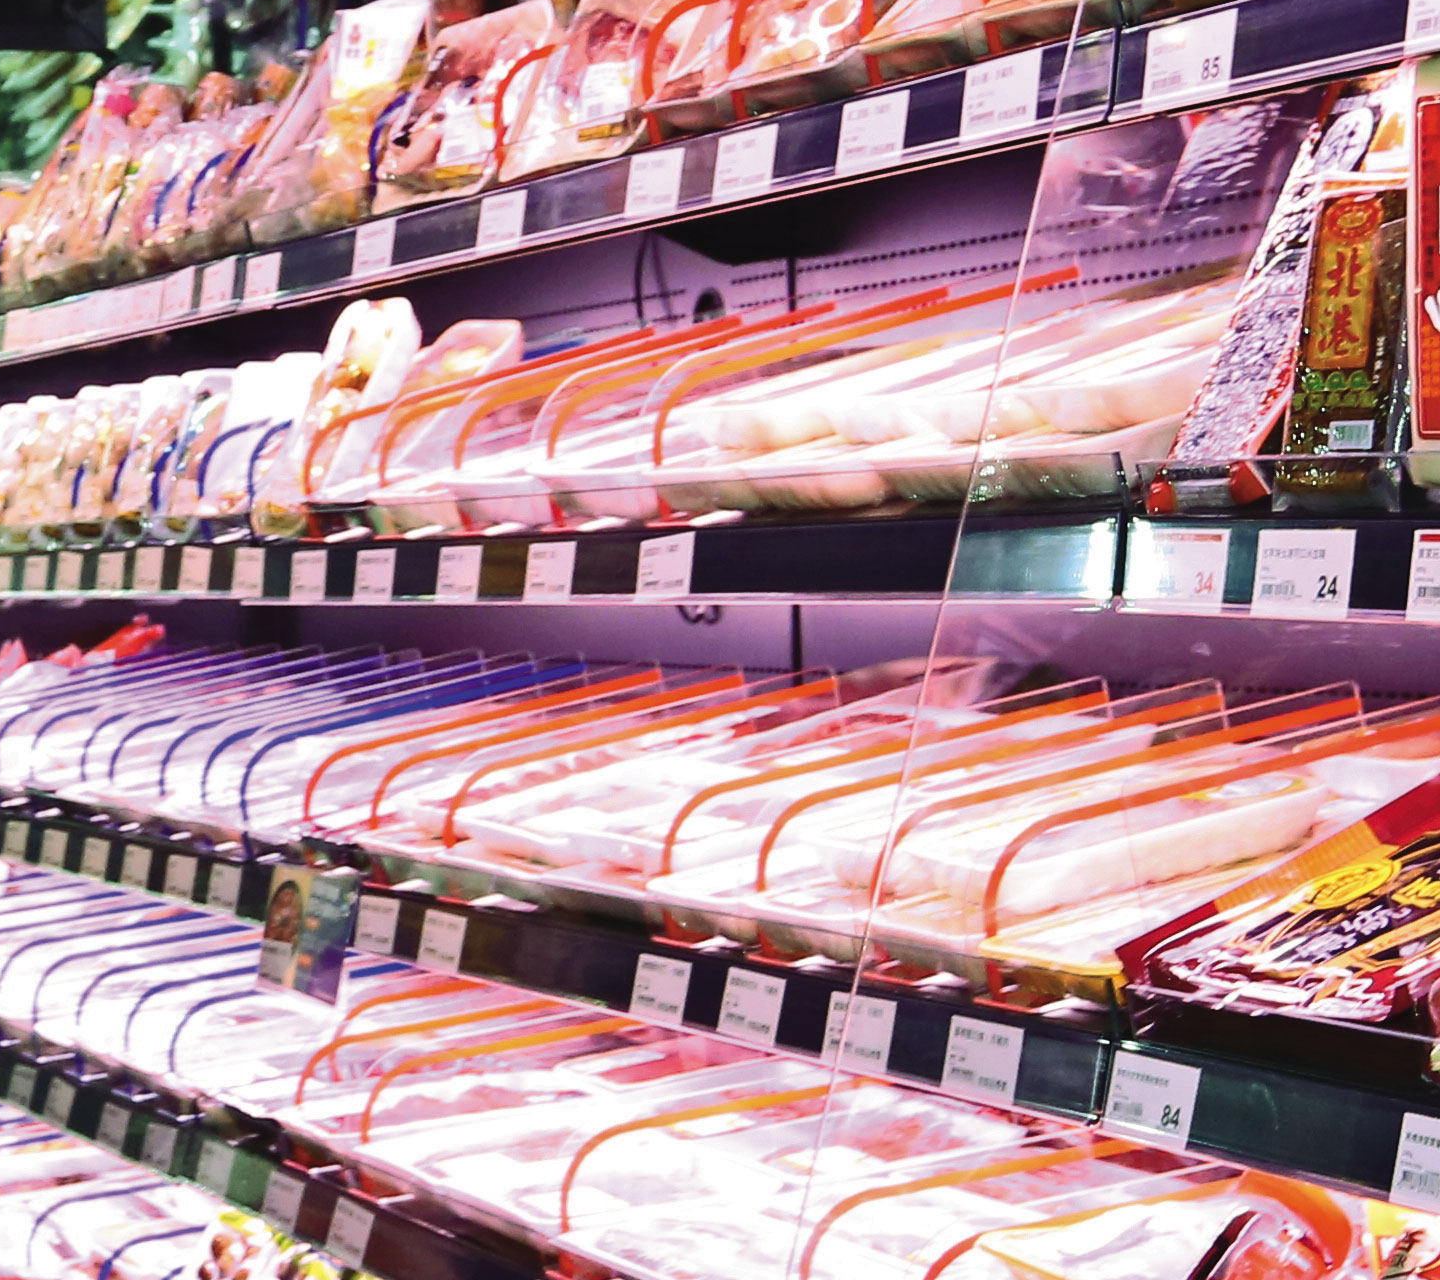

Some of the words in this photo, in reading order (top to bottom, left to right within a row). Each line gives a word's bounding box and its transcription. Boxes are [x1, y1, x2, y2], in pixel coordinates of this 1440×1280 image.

[1200, 55, 1221, 82] 85
[1193, 571, 1214, 595] 34
[1316, 575, 1339, 600] 24
[1159, 1105, 1182, 1130] 84
